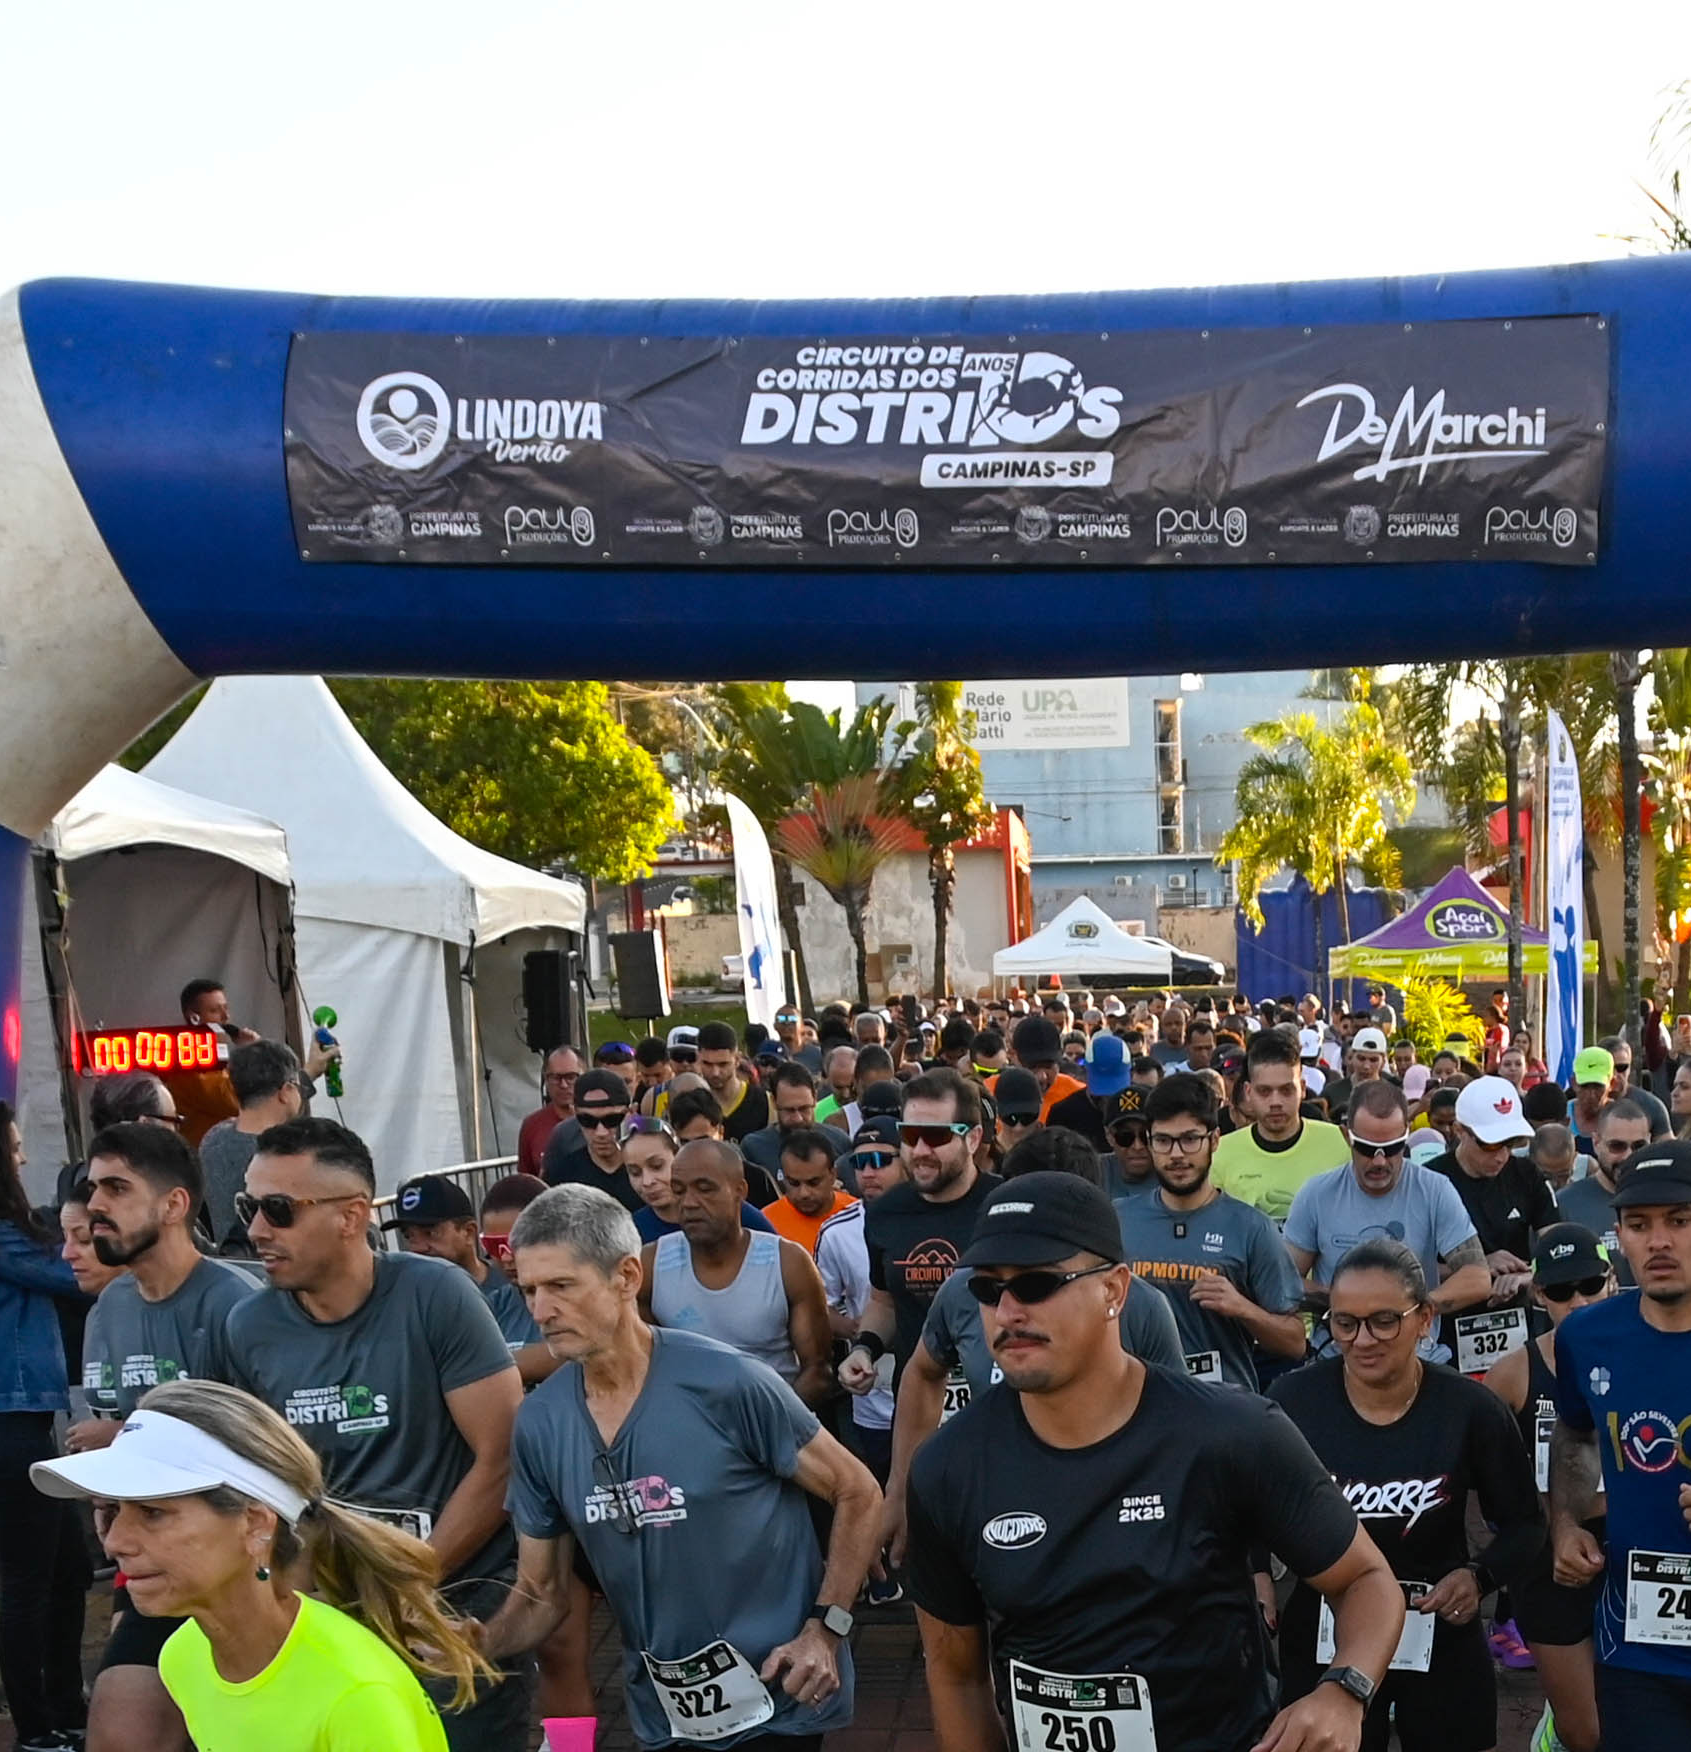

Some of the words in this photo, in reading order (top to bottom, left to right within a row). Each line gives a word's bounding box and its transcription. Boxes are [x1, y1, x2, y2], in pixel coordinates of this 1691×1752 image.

[797, 347, 926, 366] CIRCUITO
[928, 346, 964, 365] DE
[964, 357, 1016, 372] ANOS
[757, 369, 898, 390] CORRIDAS
[900, 368, 957, 388] DOS
[457, 397, 603, 441] LINDOYA
[487, 438, 571, 465] Verão
[938, 458, 1096, 480] CAMPINAS-SP
[1388, 513, 1445, 522] PREFEITURA
[411, 523, 481, 536] CAMPINAS
[732, 525, 803, 539] CAMPINAS
[1059, 524, 1131, 538] CAMPINAS
[1388, 524, 1459, 537] CAMPINAS
[966, 692, 1005, 706] Rede
[1022, 690, 1078, 712] UPA
[1436, 920, 1496, 935] Sport
[1550, 1243, 1575, 1258] vibe
[905, 1267, 942, 1281] CIRCUITO
[1474, 1332, 1508, 1355] 332
[1629, 1410, 1647, 1426] SÃO
[1123, 1495, 1161, 1508] SINCE
[1119, 1506, 1165, 1522] 2K25
[669, 1684, 731, 1718] 322
